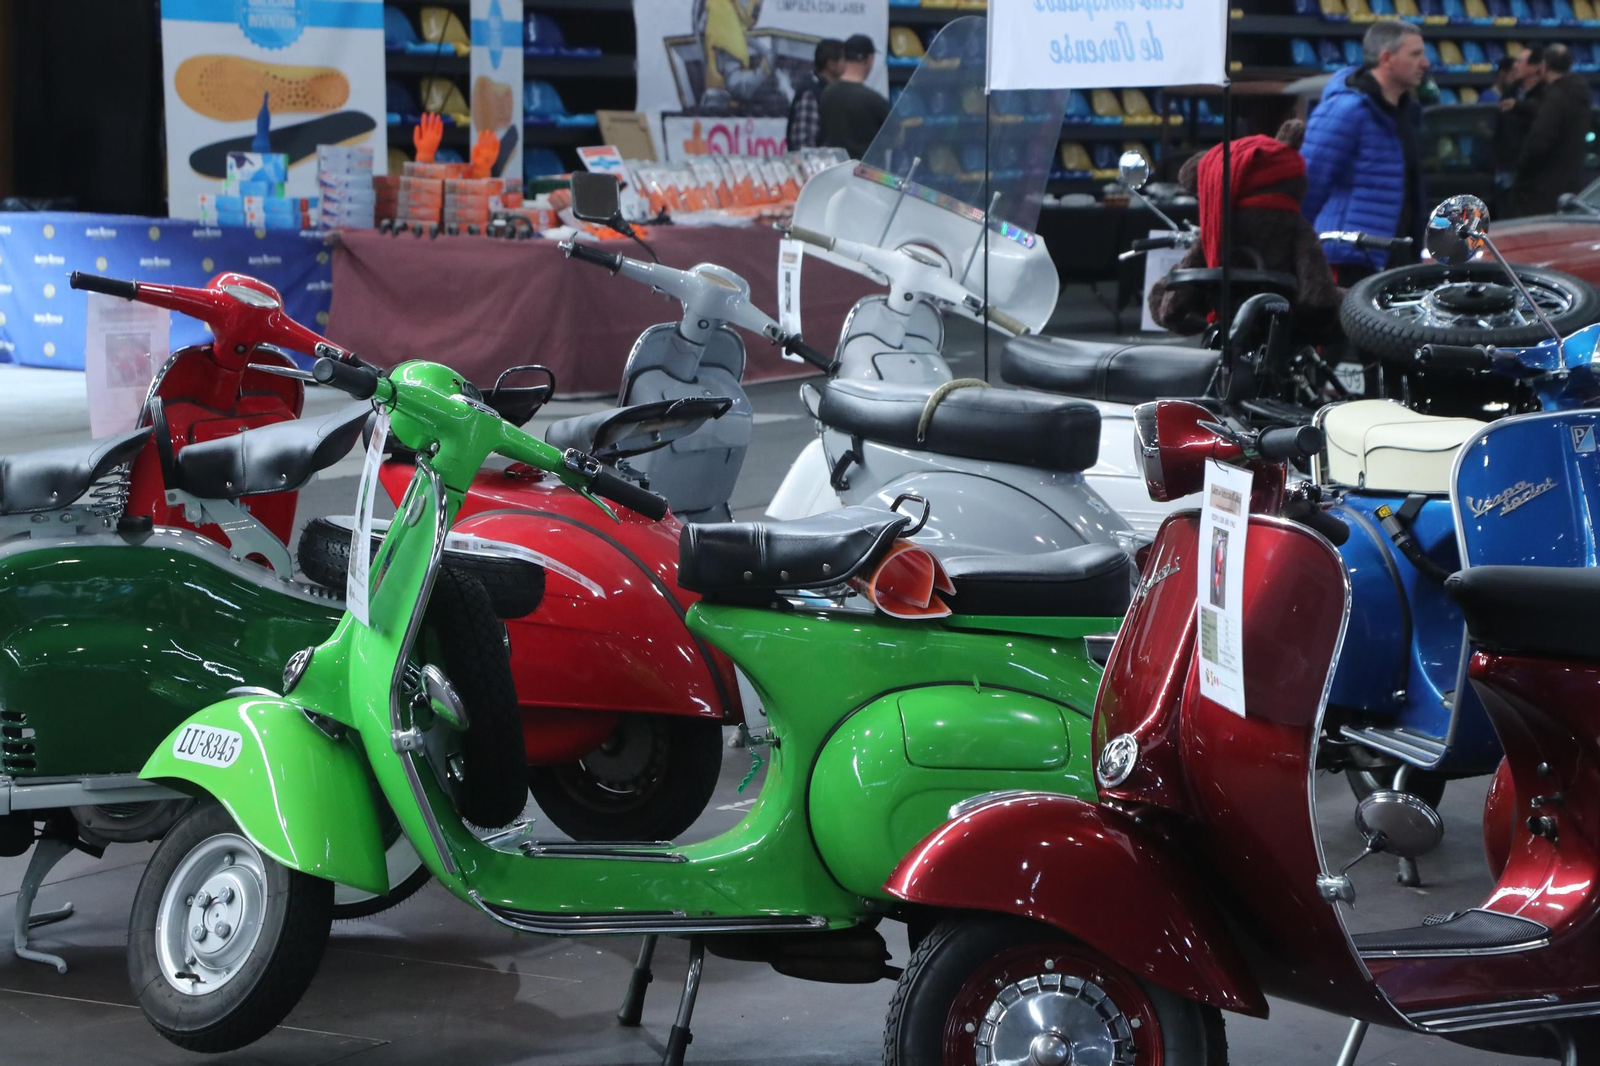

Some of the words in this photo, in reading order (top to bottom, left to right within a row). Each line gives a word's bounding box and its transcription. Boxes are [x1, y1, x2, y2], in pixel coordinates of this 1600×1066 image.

[1574, 428, 1585, 444] P
[1465, 480, 1534, 519] Vespa
[177, 727, 240, 763] LU-8345
